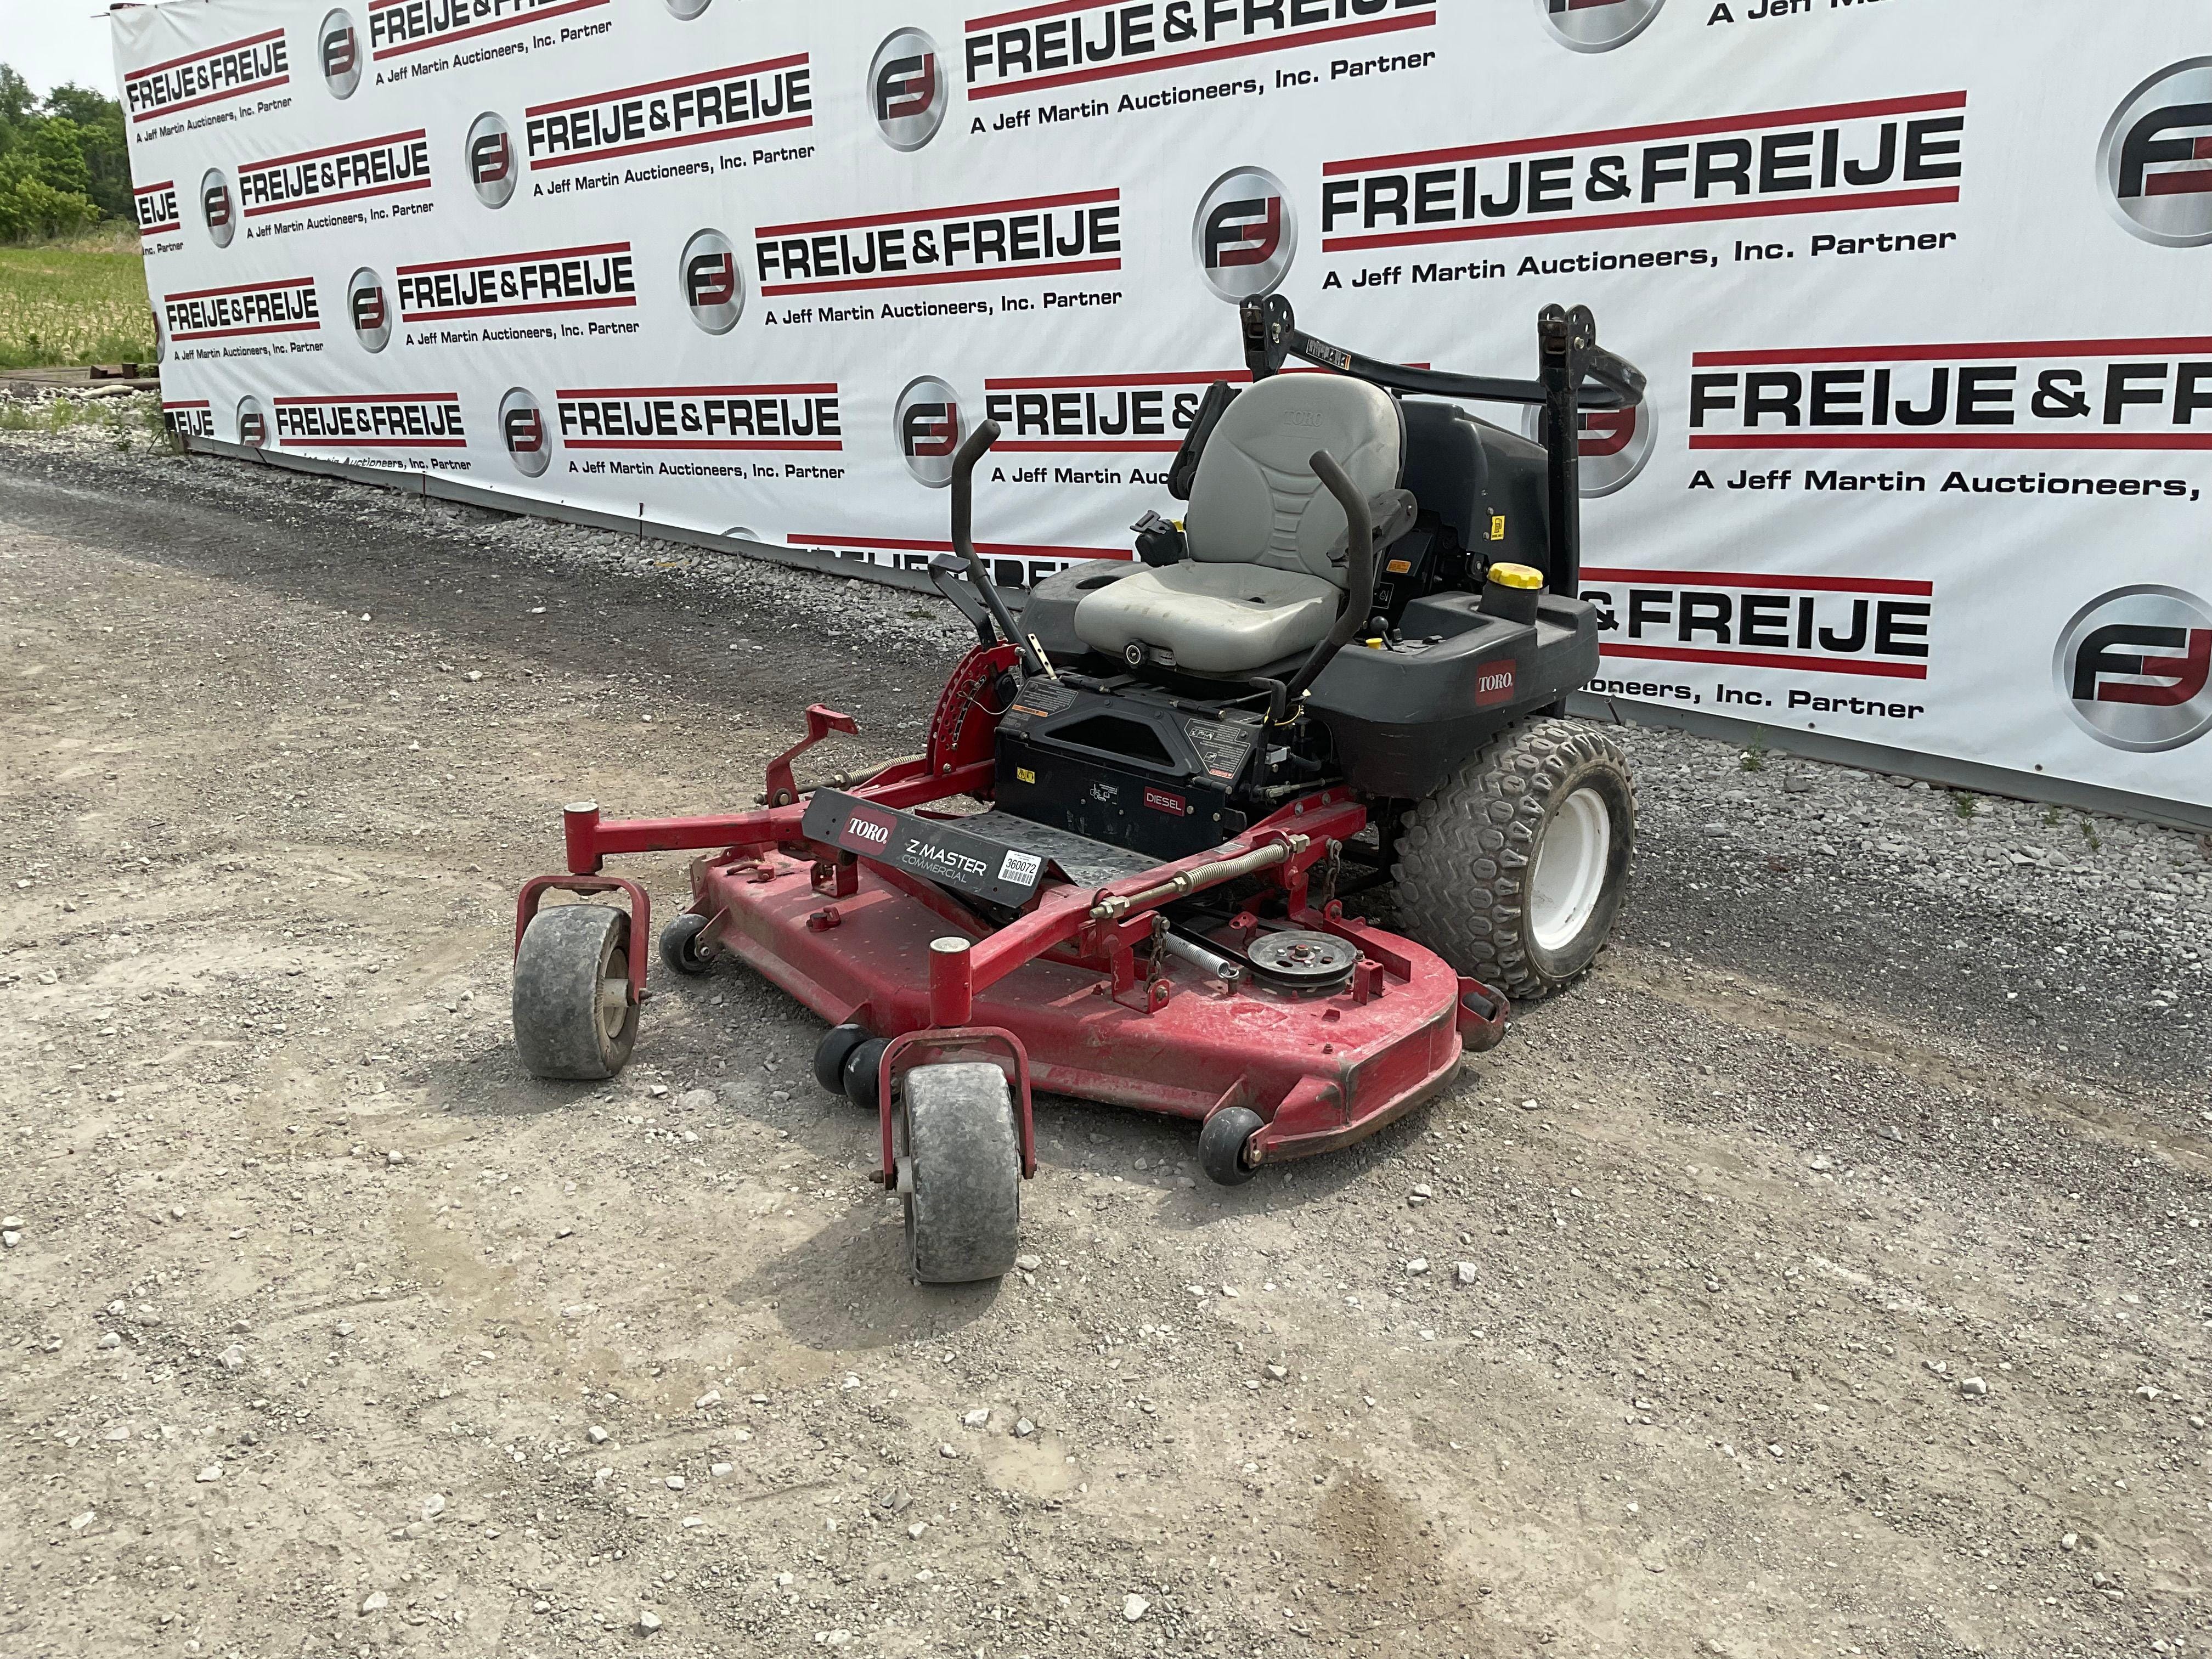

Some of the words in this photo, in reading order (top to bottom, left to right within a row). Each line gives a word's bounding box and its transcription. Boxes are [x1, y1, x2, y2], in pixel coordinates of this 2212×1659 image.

[1707, 3, 1735, 26] A
[376, 72, 385, 86] A
[387, 66, 408, 83] Jeff
[411, 58, 449, 77] Martin
[453, 42, 528, 68] Auctioneers,
[533, 36, 556, 49] Inc.
[560, 21, 612, 43] Partner
[970, 117, 986, 134] A
[993, 109, 1030, 131] Jeff
[1038, 99, 1109, 124] Martin
[1117, 79, 1264, 112] Auctioneers,
[1276, 70, 1318, 88] Inc.
[1330, 51, 1435, 80] Partner
[137, 133, 143, 144] A
[144, 128, 157, 142] Jeff
[159, 122, 185, 138] Martin
[187, 111, 237, 131] Auctioneers,
[239, 107, 255, 118] Inc.
[257, 98, 292, 114] Partner
[533, 183, 544, 197] A
[547, 178, 571, 195] Jeff
[575, 172, 619, 191] Martin
[624, 161, 714, 184] Auctioneers,
[720, 155, 747, 170] Inc.
[753, 146, 815, 165] Partner
[247, 228, 254, 239] A
[256, 224, 272, 238] Jeff
[274, 220, 304, 235] Martin
[307, 213, 367, 230] Auctioneers,
[370, 209, 389, 220] Inc.
[392, 202, 434, 217] Partner
[156, 242, 184, 253] Partner
[1322, 270, 1342, 290] A
[1352, 266, 1402, 287] Jeff
[1412, 259, 1505, 283] Martin
[1516, 249, 1718, 276] Auctioneers,
[1735, 242, 1793, 261] Inc.
[1811, 232, 1956, 257] Partner
[765, 311, 778, 325] A
[782, 308, 812, 324] Jeff
[818, 305, 874, 322] Martin
[881, 301, 993, 319] Auctioneers,
[1001, 296, 1034, 311] Inc.
[1043, 292, 1122, 308] Partner
[406, 334, 415, 346] A
[417, 332, 437, 345] Jeff
[441, 330, 478, 343] Martin
[482, 327, 557, 341] Auctioneers,
[561, 324, 584, 337] Inc.
[588, 322, 640, 335] Partner
[174, 351, 180, 360] A
[182, 349, 194, 360] Jeff
[196, 348, 221, 359] Martin
[223, 346, 271, 357] Auctioneers,
[272, 343, 288, 354] Inc.
[289, 342, 324, 353] Partner
[409, 458, 428, 469] Inc.
[431, 458, 471, 470] Partner
[569, 460, 579, 473] A
[582, 461, 606, 473] Jeff
[609, 461, 654, 475] Martin
[659, 462, 747, 479] Auctioneers,
[752, 464, 778, 477] Inc.
[785, 464, 845, 479] Partner
[991, 467, 1006, 482] A
[1012, 467, 1047, 483] Jeff
[1054, 468, 1121, 484] Martin
[1688, 470, 1715, 489] A
[1727, 470, 1791, 489] Jeff
[1804, 470, 1925, 492] Martin
[1939, 471, 2199, 501] Auctioneers,
[1479, 672, 1513, 692] TORO
[1716, 684, 1771, 707] Inc.
[1788, 690, 1924, 719] Partner
[1147, 792, 1182, 811] DIESEL
[848, 817, 888, 844] TORO
[901, 854, 967, 883] COMMERCIAL
[906, 839, 920, 854] Z
[919, 843, 987, 876] MASTER
[1006, 858, 1036, 874] 360072
